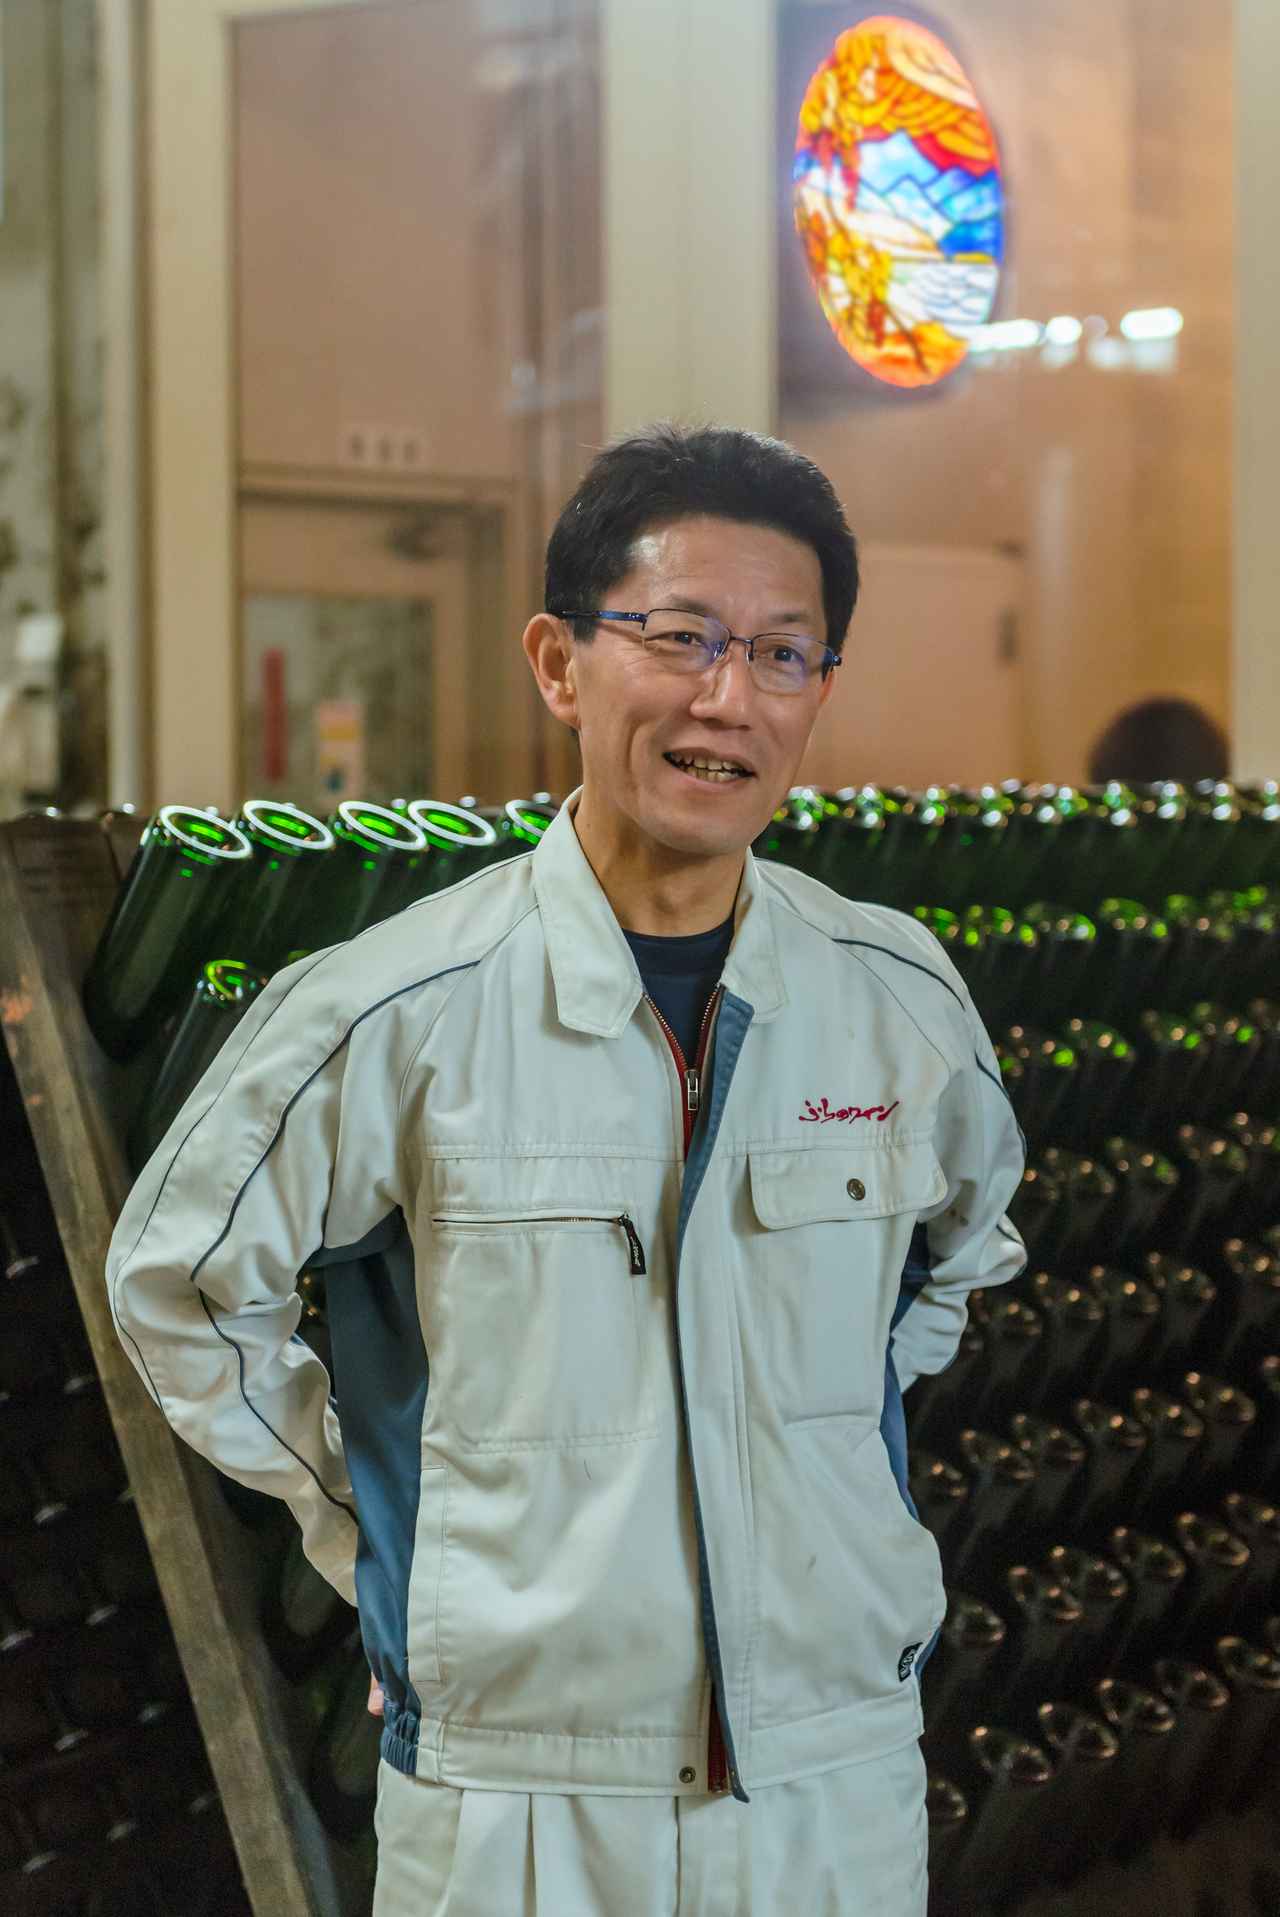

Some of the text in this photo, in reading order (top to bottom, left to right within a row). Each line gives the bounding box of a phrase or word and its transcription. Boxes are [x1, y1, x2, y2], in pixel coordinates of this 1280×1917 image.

[798, 1097, 900, 1124] ふらのワイン
